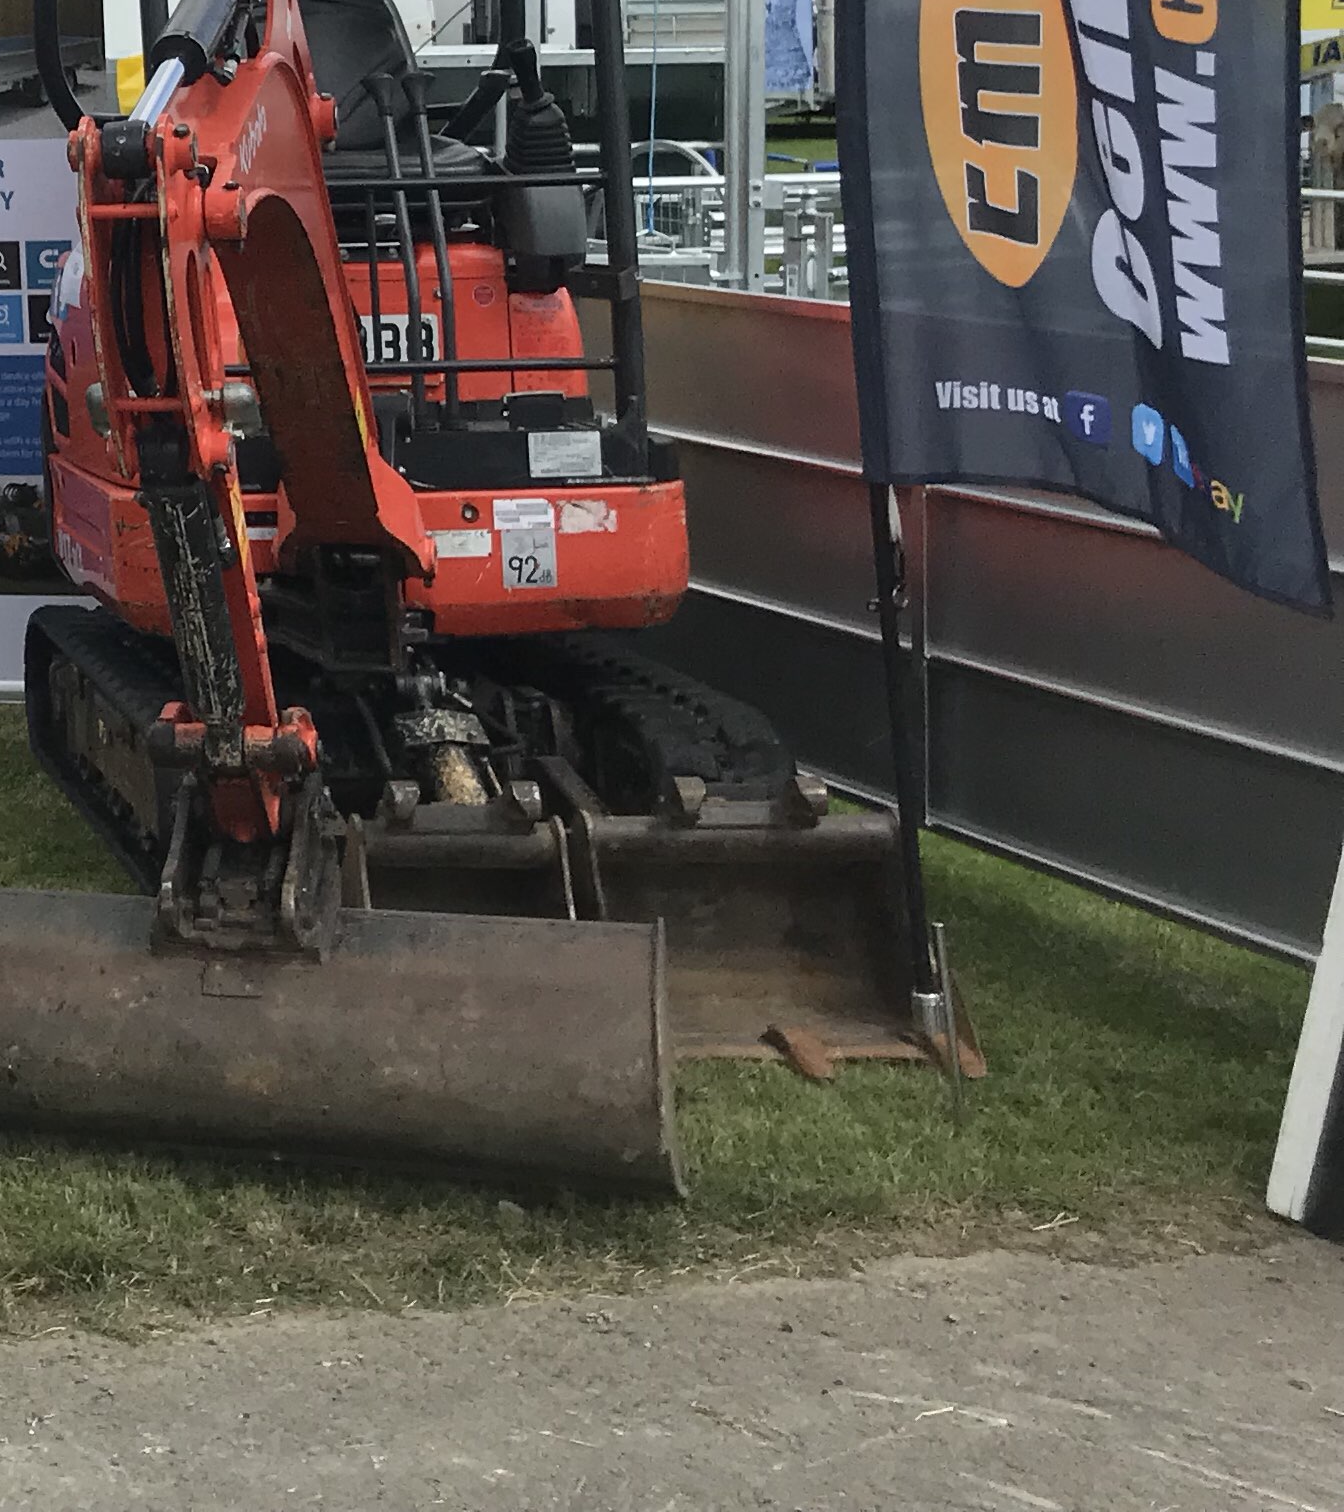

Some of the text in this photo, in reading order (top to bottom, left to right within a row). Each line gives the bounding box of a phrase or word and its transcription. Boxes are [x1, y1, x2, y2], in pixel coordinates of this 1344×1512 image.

[238, 103, 267, 175] Kubota
[935, 380, 1001, 410] Visit
[1007, 388, 1040, 415] us
[1042, 394, 1062, 424] at
[508, 556, 540, 584] 92
